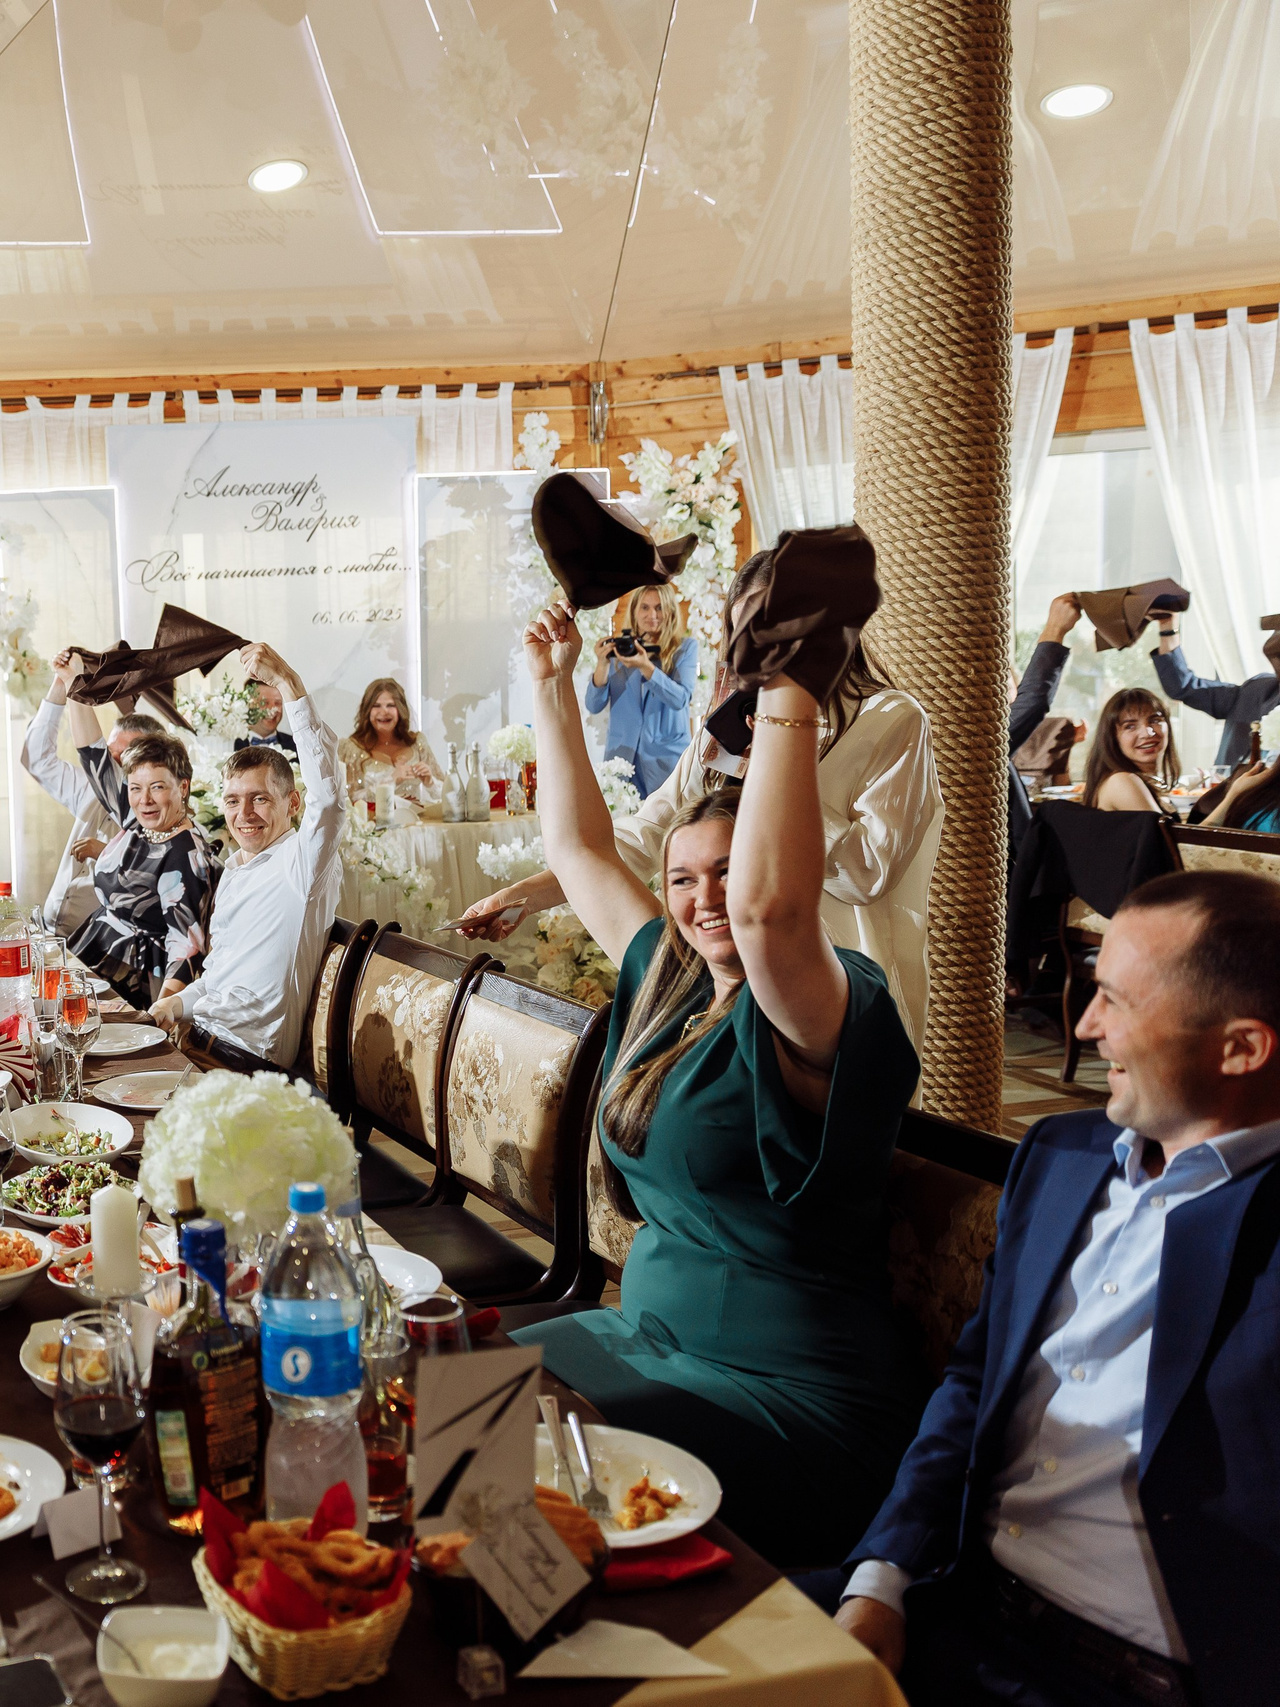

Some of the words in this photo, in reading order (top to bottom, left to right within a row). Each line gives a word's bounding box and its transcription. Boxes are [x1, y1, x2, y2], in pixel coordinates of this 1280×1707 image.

[184, 465, 321, 507] Александр
[244, 500, 360, 543] Валерия
[125, 550, 195, 593] Всё
[197, 565, 318, 580] начинается
[323, 565, 333, 574] с
